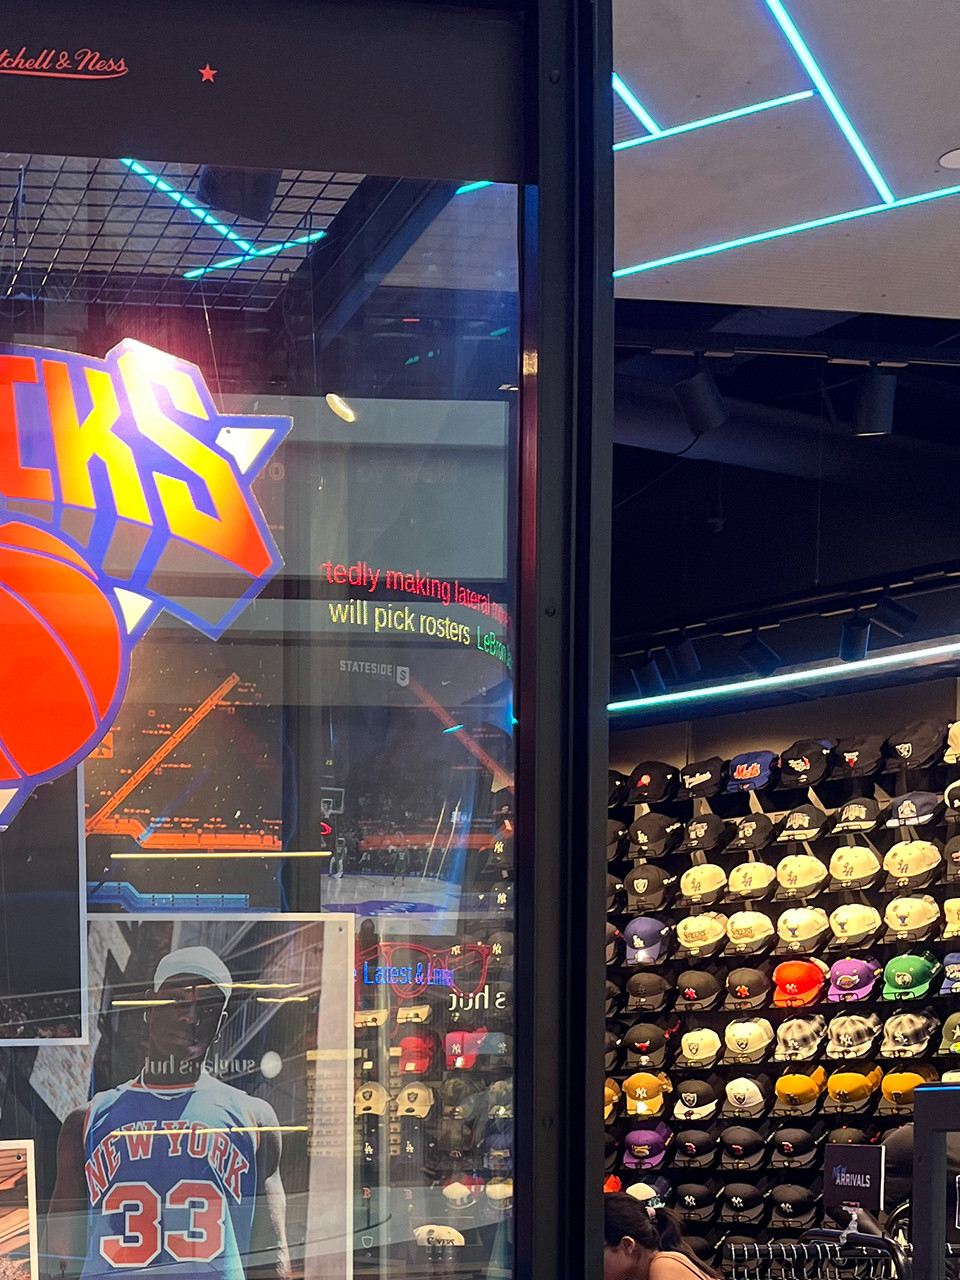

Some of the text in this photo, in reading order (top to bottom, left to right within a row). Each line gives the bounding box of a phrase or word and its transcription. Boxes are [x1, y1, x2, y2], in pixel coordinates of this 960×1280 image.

[56, 51, 72, 70] &
[74, 48, 128, 74] Ness
[386, 569, 450, 606] making
[454, 580, 490, 615] lateral
[329, 599, 368, 625] will
[375, 604, 415, 632] pick
[420, 615, 470, 645] rosters
[340, 660, 393, 676] STATESIDE
[733, 762, 760, 779] Mets
[363, 961, 412, 985] Latest
[415, 962, 425, 985] &
[85, 1121, 250, 1206] NEW YORK
[836, 1174, 871, 1188] ARRIVALS
[100, 1179, 227, 1268] 33
